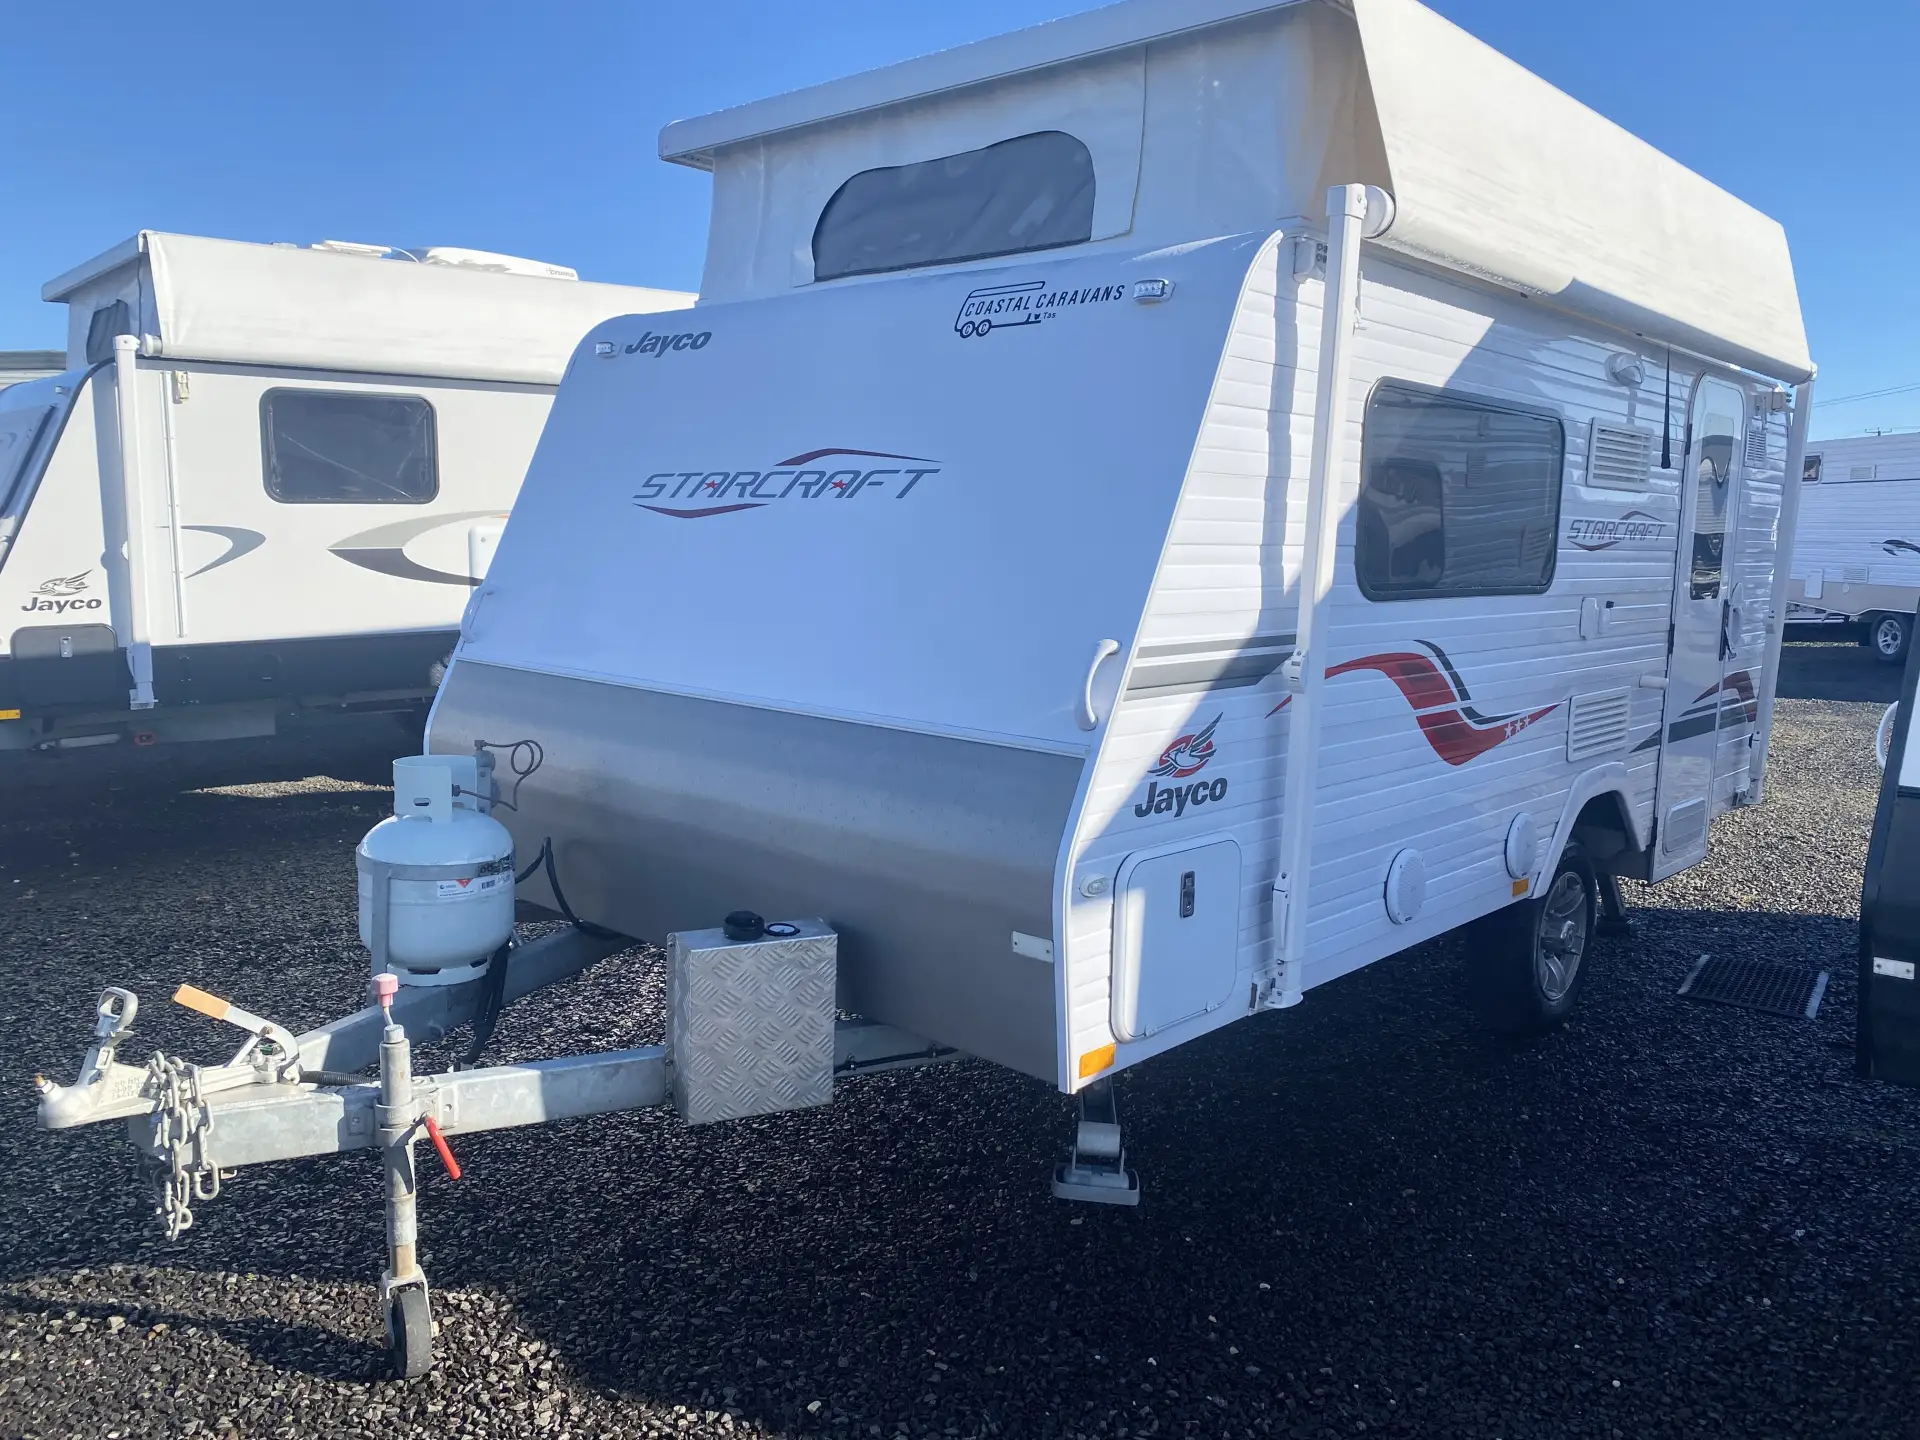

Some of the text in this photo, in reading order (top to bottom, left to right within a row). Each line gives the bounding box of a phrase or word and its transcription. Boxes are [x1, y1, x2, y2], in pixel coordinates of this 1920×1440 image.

[964, 285, 1126, 317] COASTAL CARAVANS
[625, 331, 712, 358] Jayco
[632, 468, 941, 499] STARCRAFT
[1567, 519, 1667, 541] STARCRAFT
[21, 597, 102, 614] Jayco
[1134, 777, 1228, 818] Jayco
